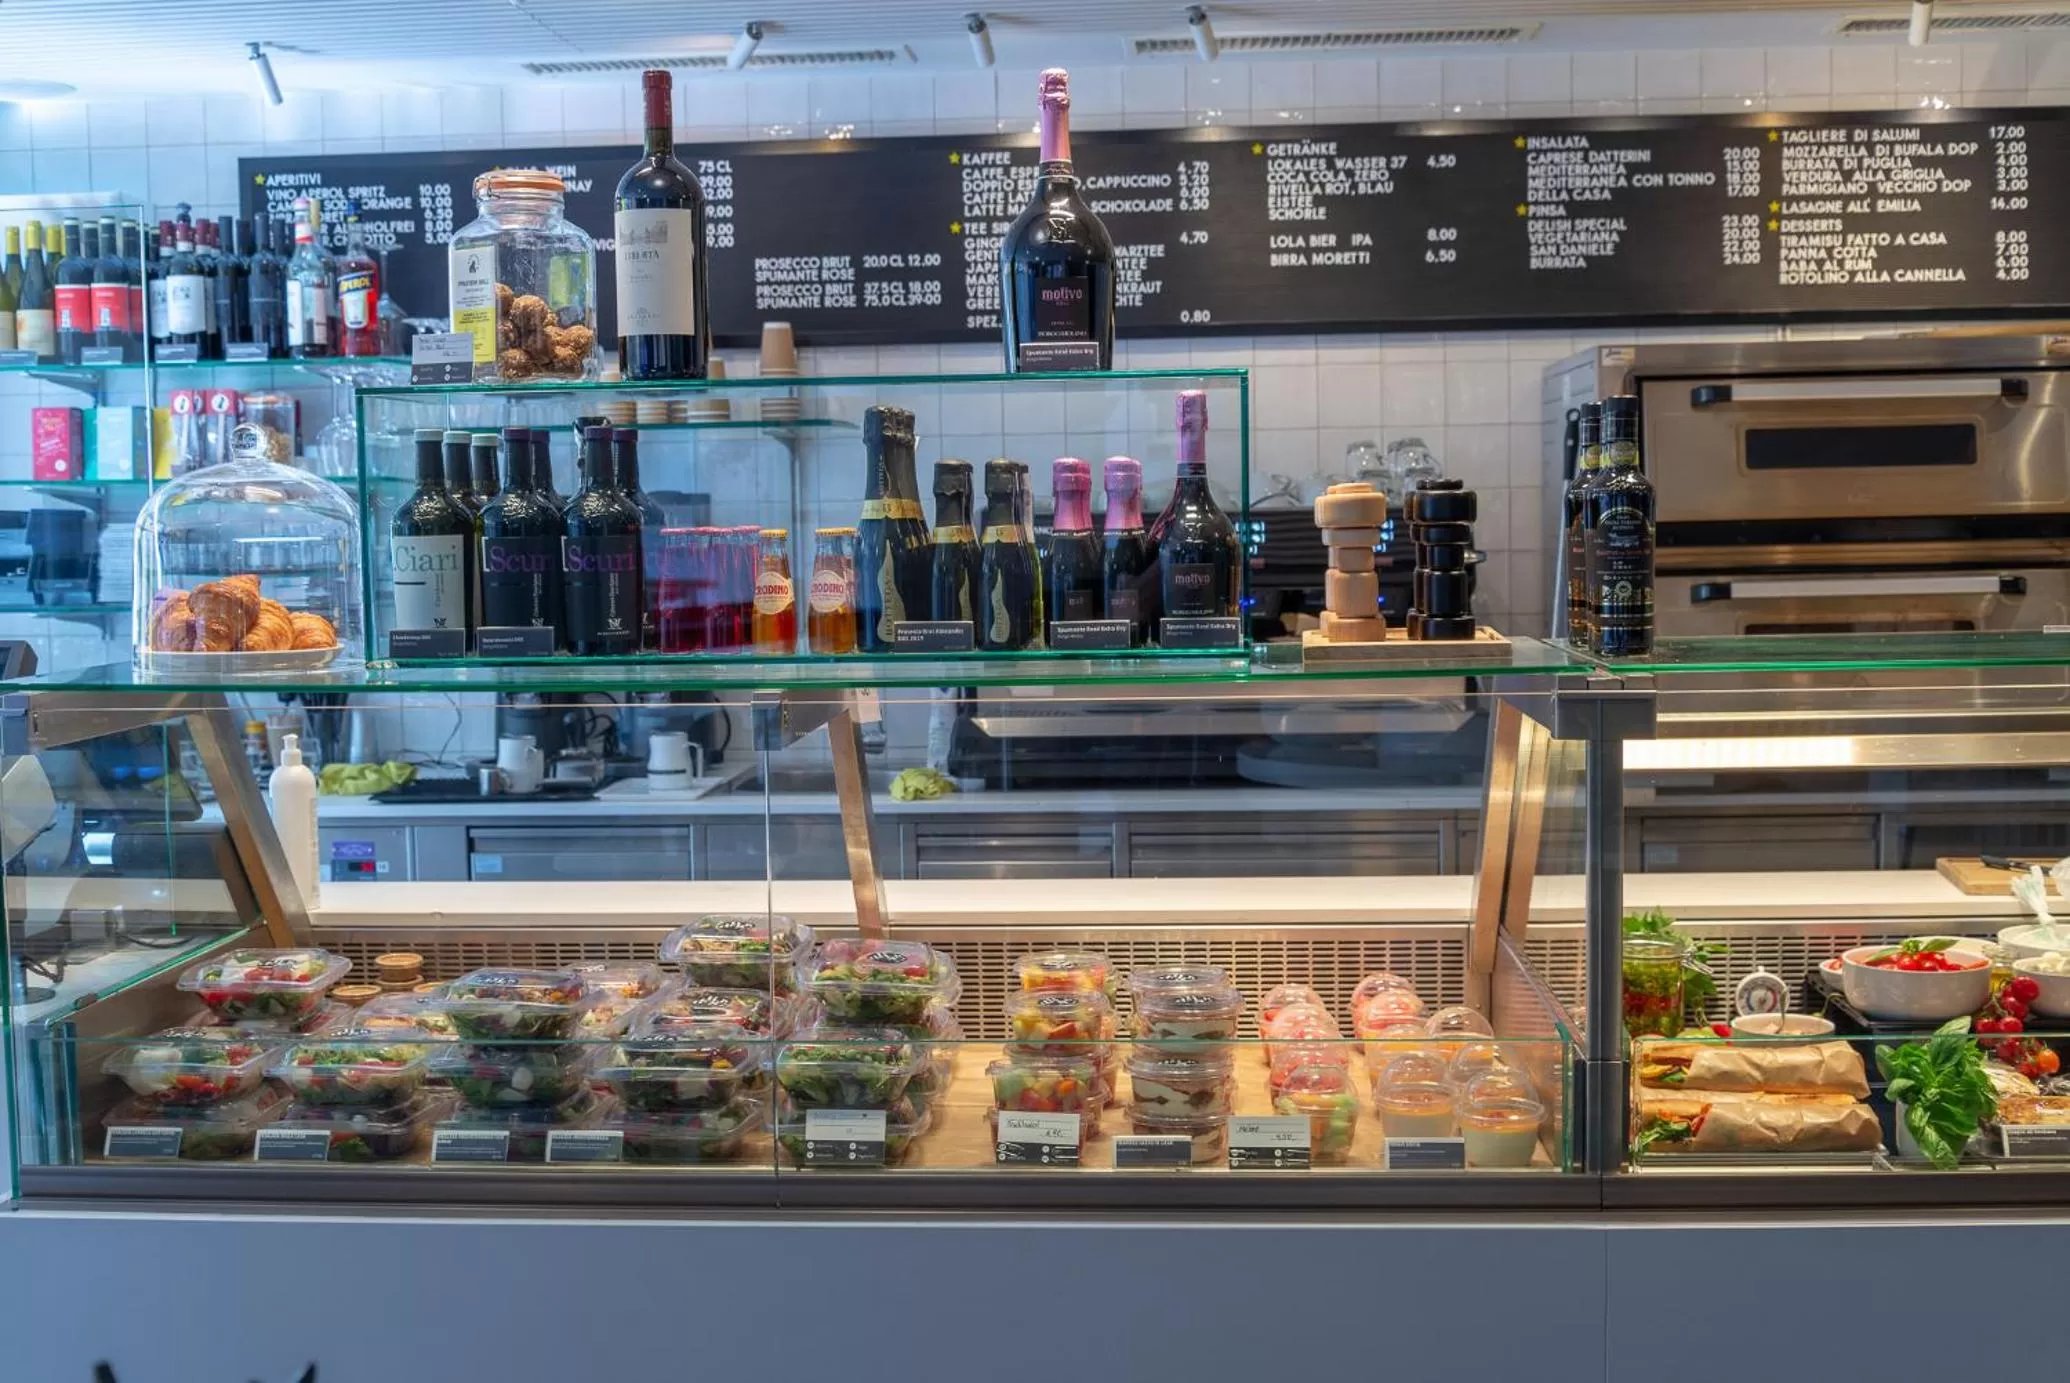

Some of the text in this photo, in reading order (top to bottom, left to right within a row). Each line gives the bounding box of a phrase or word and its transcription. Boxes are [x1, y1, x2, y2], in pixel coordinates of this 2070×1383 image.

[1527, 136, 1589, 149] INSALATA
[1782, 126, 2025, 143] TAGLIERE DI SALUMI 17.00
[1267, 140, 1337, 156] GETRÄNKE
[1527, 147, 1760, 164] CAPRESE DATTERINI 20.00
[1782, 141, 2027, 158] MOZZARELLA DI BUFALA DOP 2.00
[698, 160, 715, 173] 75
[716, 160, 733, 173] CL
[962, 152, 1011, 165] KAFFEE
[1267, 154, 1457, 171] LOKALES WASSER 37 4.50
[1782, 154, 2028, 170] BURRATA DI PUGLIA 4.00
[1178, 161, 1209, 174] 4.70
[1528, 160, 1760, 177] MEDITERRANEA 15.00
[1782, 166, 2029, 184] VERDURA ALLA GRIGLIA 3.00
[266, 173, 321, 187] APERITIVI
[699, 174, 733, 188] 39.00
[962, 180, 1015, 192] DOPPIO
[1179, 174, 1209, 187] 5.20
[1267, 172, 1306, 183] COCA
[1354, 169, 1389, 182] ZERO
[1528, 172, 1760, 188] MEDITERRANEA CON TONNO 18.00
[267, 184, 451, 201] VINO APEROL SPRITZ 10.00
[963, 192, 1005, 204] CAFFE
[1180, 186, 1209, 198] 6.00
[1268, 183, 1322, 196] RIVELLA
[1358, 180, 1394, 194] BLAU
[1527, 184, 1760, 201] DELLA CASA 17.00
[1781, 179, 2029, 196] PARMIGIANO VECCHIO DOP 3.00
[324, 199, 350, 211] SOD
[420, 196, 452, 209] 10.00
[964, 204, 1004, 217] LATTE
[1090, 198, 1173, 213] SCHOKOLADE
[1180, 198, 1209, 211] 6.50
[1268, 196, 1313, 208] EISTEE
[1781, 200, 1843, 214] LASAGNE
[1876, 199, 1922, 213] EMILIA
[1990, 197, 2028, 210] 14.00
[424, 208, 453, 220] 6.50
[1528, 204, 1567, 217] PINSA
[425, 220, 453, 232] 8.00
[1574, 218, 1627, 231] SPECIAL
[1722, 215, 1760, 227] 23.00
[1780, 218, 1843, 233] DESSERTS
[964, 222, 1208, 244] TEE 4.70
[1270, 228, 1457, 248] LOLA BIER IPA 8.00
[1529, 227, 1760, 244] VEGETARIANA 20.00
[1779, 230, 2027, 248] TIRAMISU FATTO A CASA 8.00
[1114, 244, 1165, 257] WARZTEE
[1530, 240, 1760, 256] SAN DANIELE 22.00
[1779, 243, 2029, 260] PANNA COTTA 7.00
[755, 253, 941, 270] PROSECCO BRUT 20.0 CL 12.00
[1270, 250, 1457, 266] BIRRA MORETTI 6.50
[1530, 252, 1761, 269] BURRATA 24.00
[1779, 255, 2029, 272] BABA AL RUM 6.00
[755, 267, 855, 282] SPUMANTE ROSE
[1779, 267, 2029, 285] ROTOLINO ALLA CANNELLA 4.00
[756, 280, 941, 297] PROSECCO BRUT 37.5 CL 18.00
[1041, 286, 1083, 301] motivo
[756, 295, 821, 309] SPUMANTE
[824, 295, 857, 308] ROSE
[864, 294, 890, 307] 75.0
[891, 293, 907, 306] CL
[1180, 310, 1210, 323] 0.80
[393, 544, 460, 572] Ciari
[567, 543, 635, 573] Scuri
